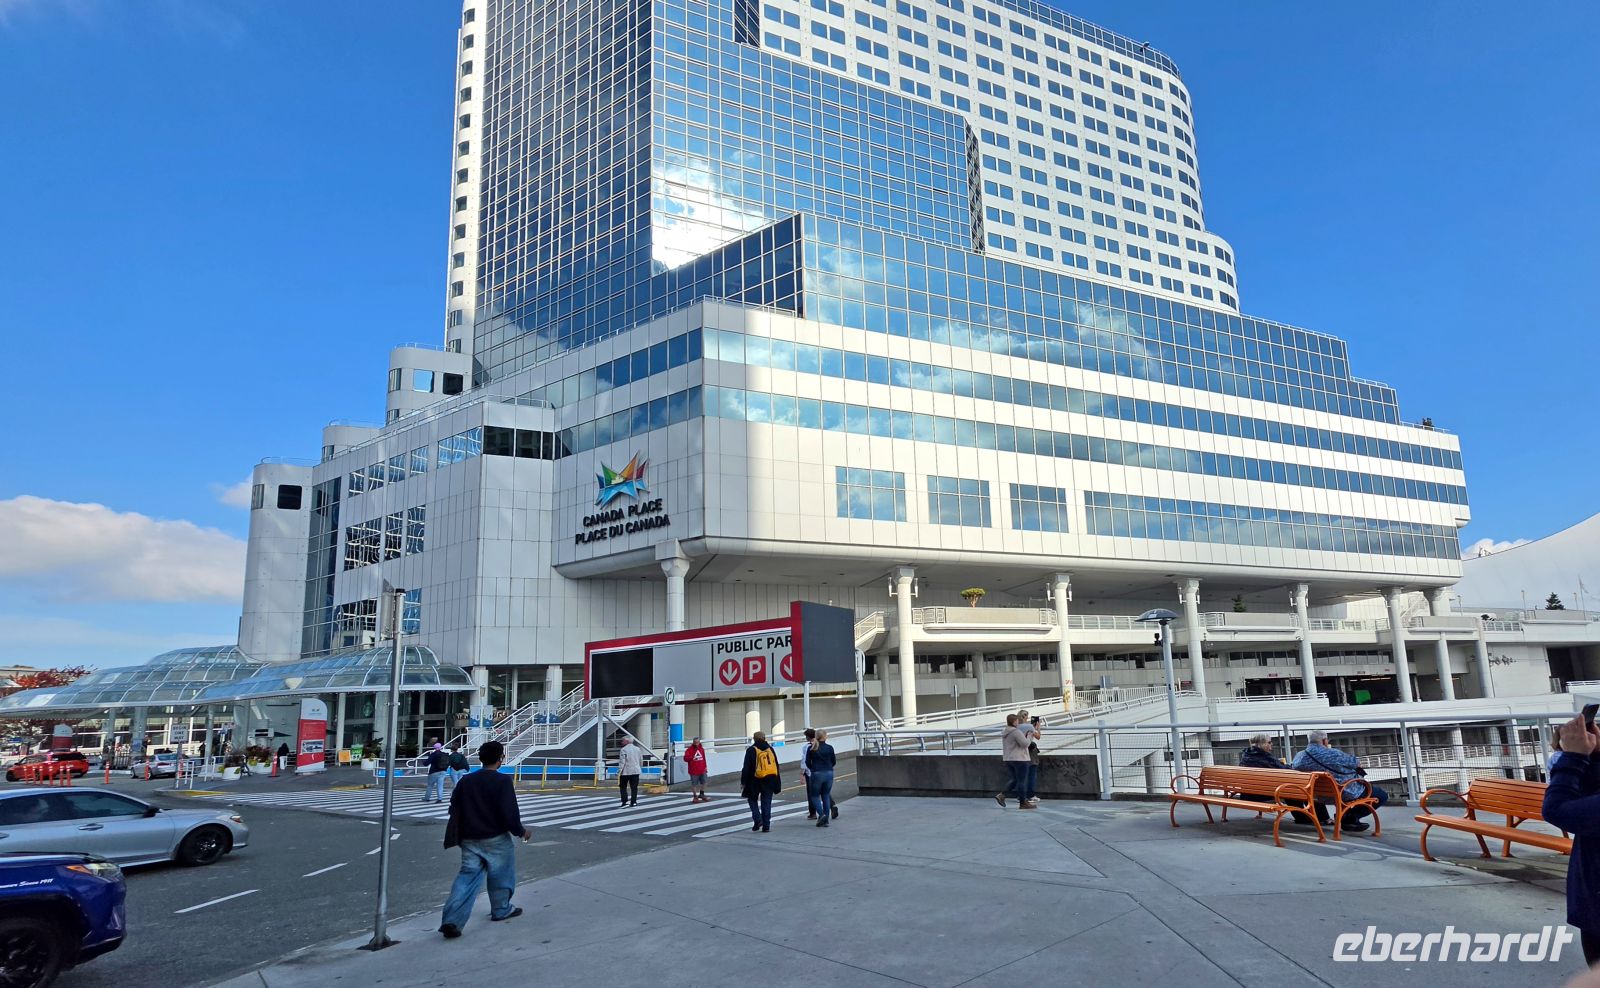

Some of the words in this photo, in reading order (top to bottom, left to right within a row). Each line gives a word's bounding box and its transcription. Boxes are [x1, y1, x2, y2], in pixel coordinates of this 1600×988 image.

[583, 508, 624, 527] CANADA
[628, 499, 663, 517] PLACE
[575, 529, 608, 544] PLACE
[609, 523, 624, 538] DU
[625, 515, 670, 534] CANADA
[717, 638, 763, 654] PUBLIC
[748, 660, 762, 680] P
